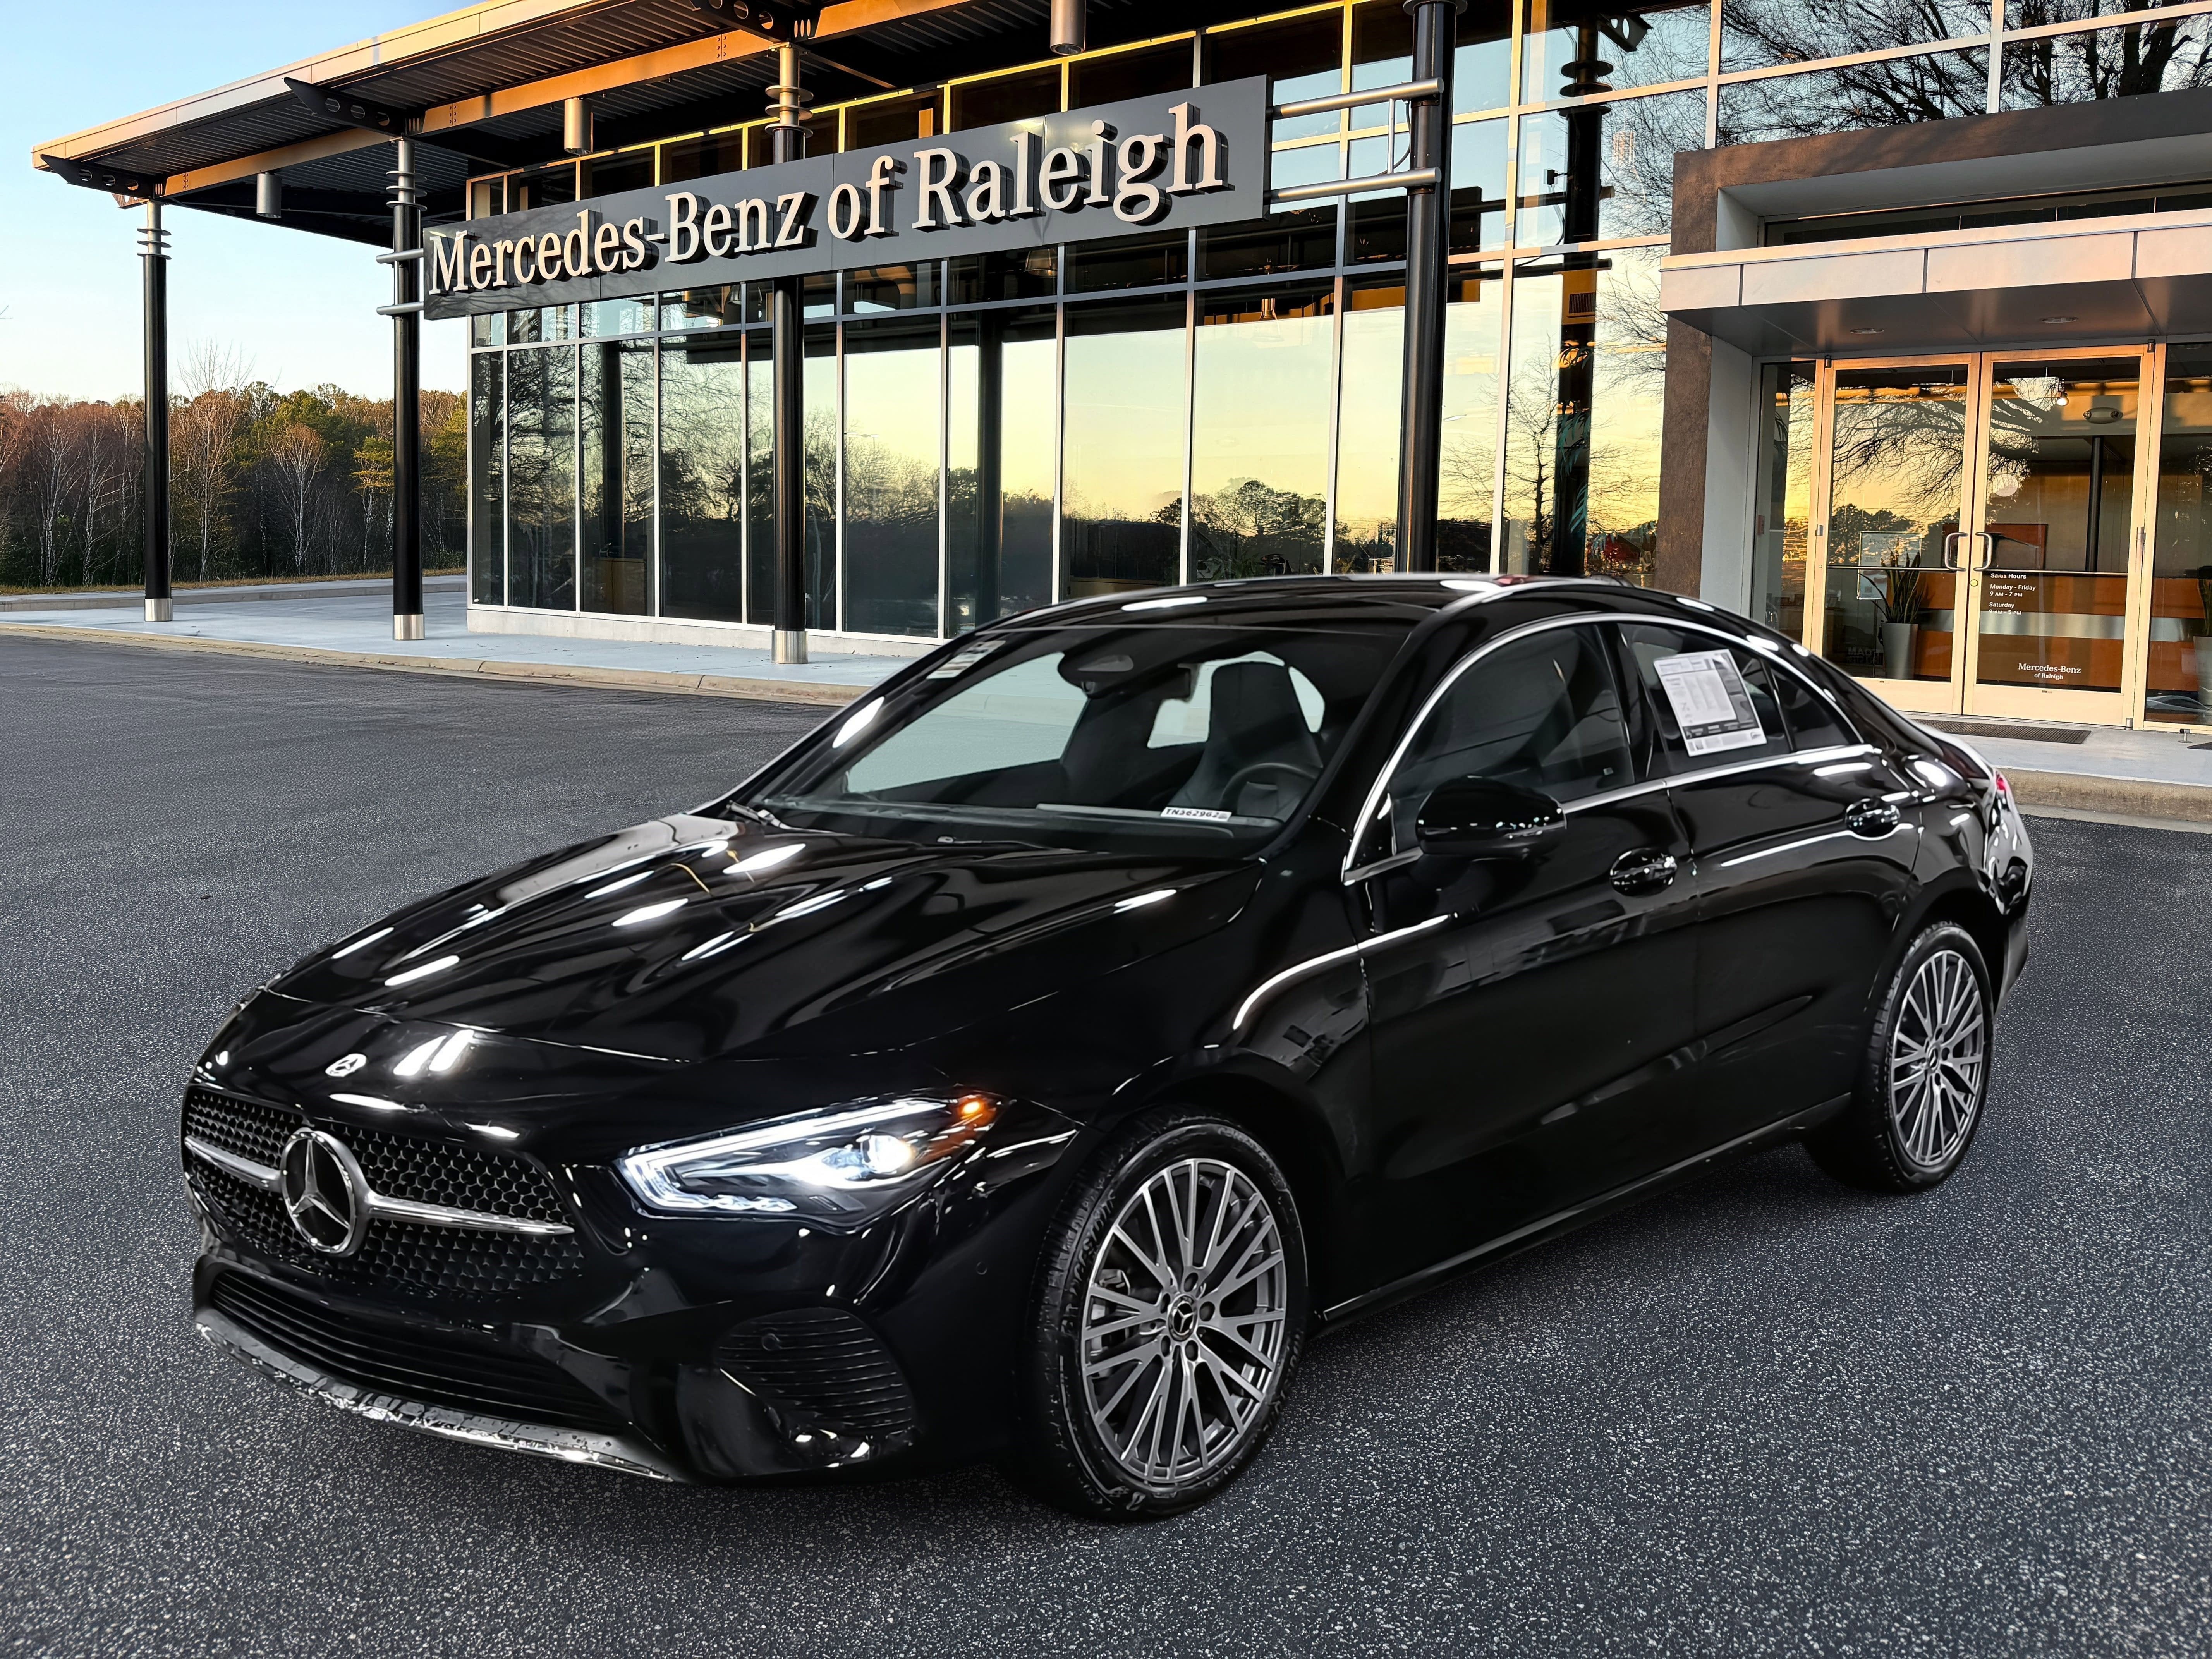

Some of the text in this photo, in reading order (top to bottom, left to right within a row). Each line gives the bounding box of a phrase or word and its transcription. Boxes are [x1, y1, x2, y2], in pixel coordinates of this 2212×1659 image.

[429, 101, 1223, 295] Mercedes-Benz of Raleigh
[2018, 663, 2081, 673] Mercedes-Benz
